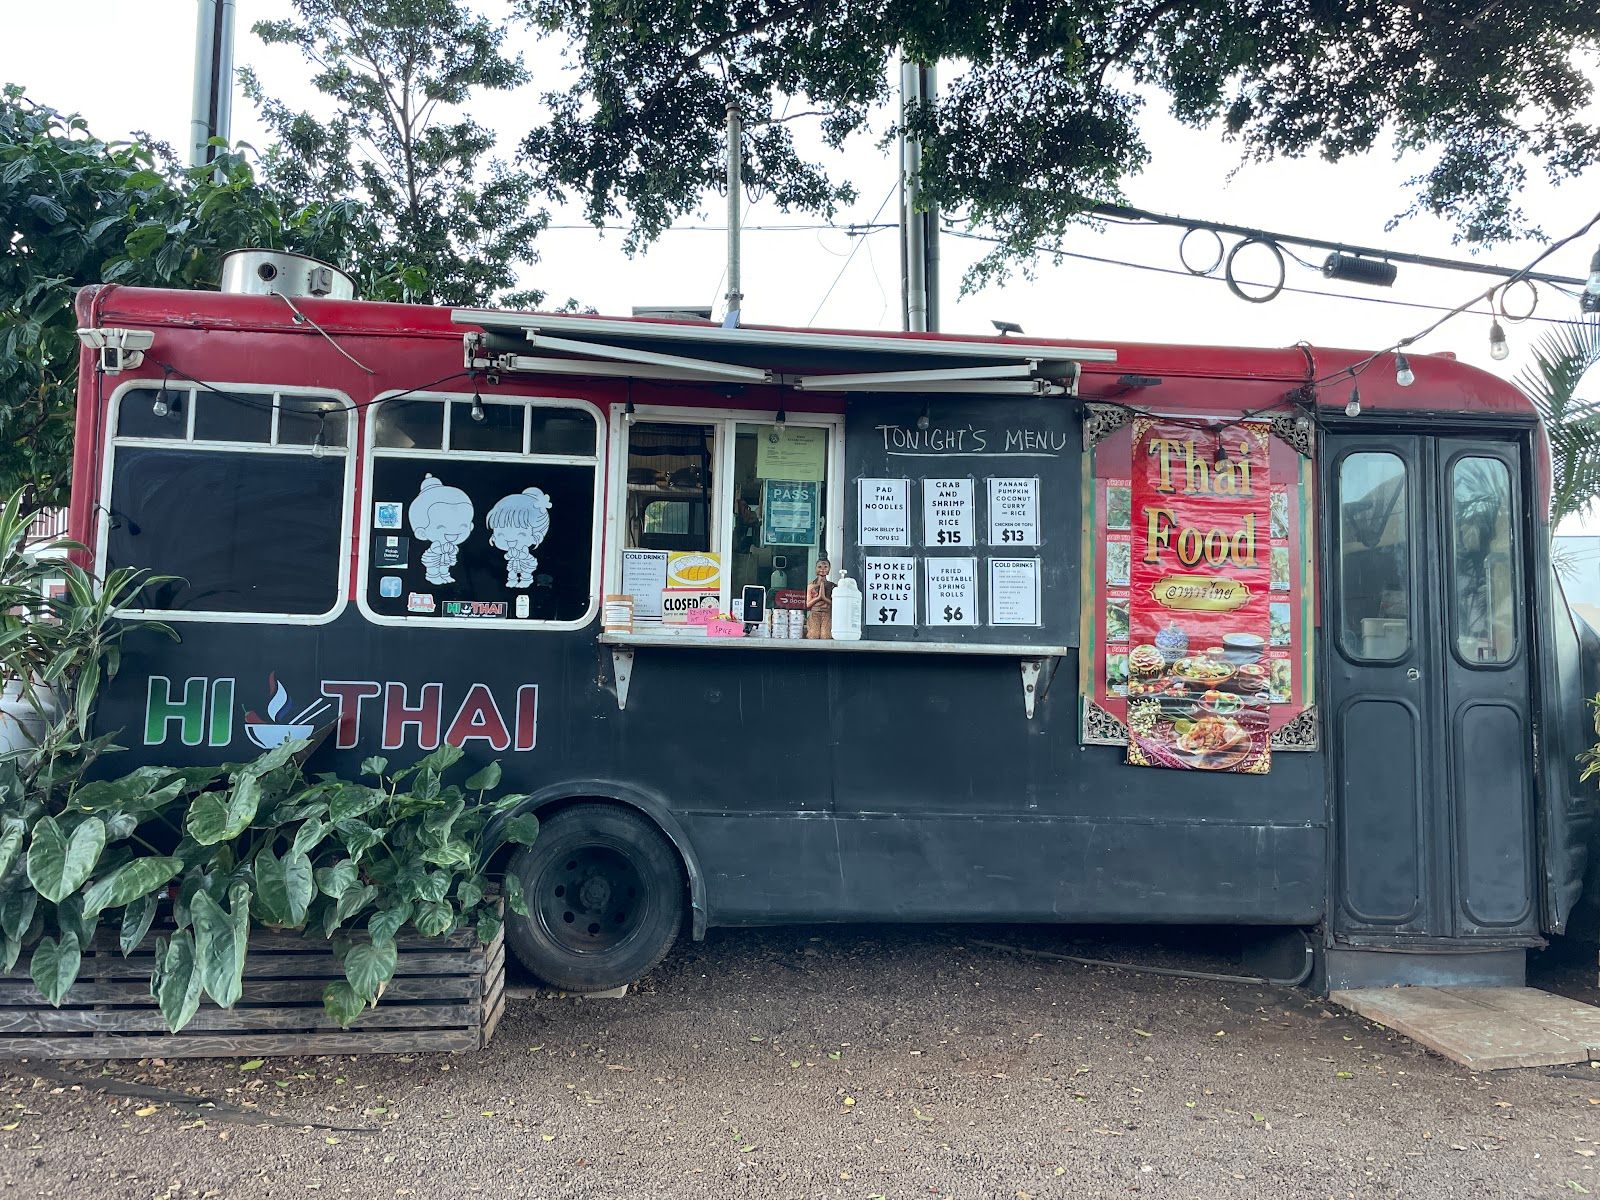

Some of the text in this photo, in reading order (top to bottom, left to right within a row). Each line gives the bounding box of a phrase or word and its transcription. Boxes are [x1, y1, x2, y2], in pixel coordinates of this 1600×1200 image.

[875, 424, 1066, 451] TONIGHT'S MENU
[1148, 438, 1254, 495] Thai
[773, 488, 809, 500] PASS
[937, 529, 961, 545] $15
[1002, 528, 1024, 543] $13
[1143, 507, 1258, 568] Food
[1165, 581, 1236, 600] อาหารไทย
[447, 602, 503, 614] HI THAI
[664, 598, 699, 610] CLOSED
[879, 606, 898, 624] $7
[944, 605, 963, 622] $6
[715, 626, 732, 635] SPICE
[144, 675, 538, 751] HI THAI
